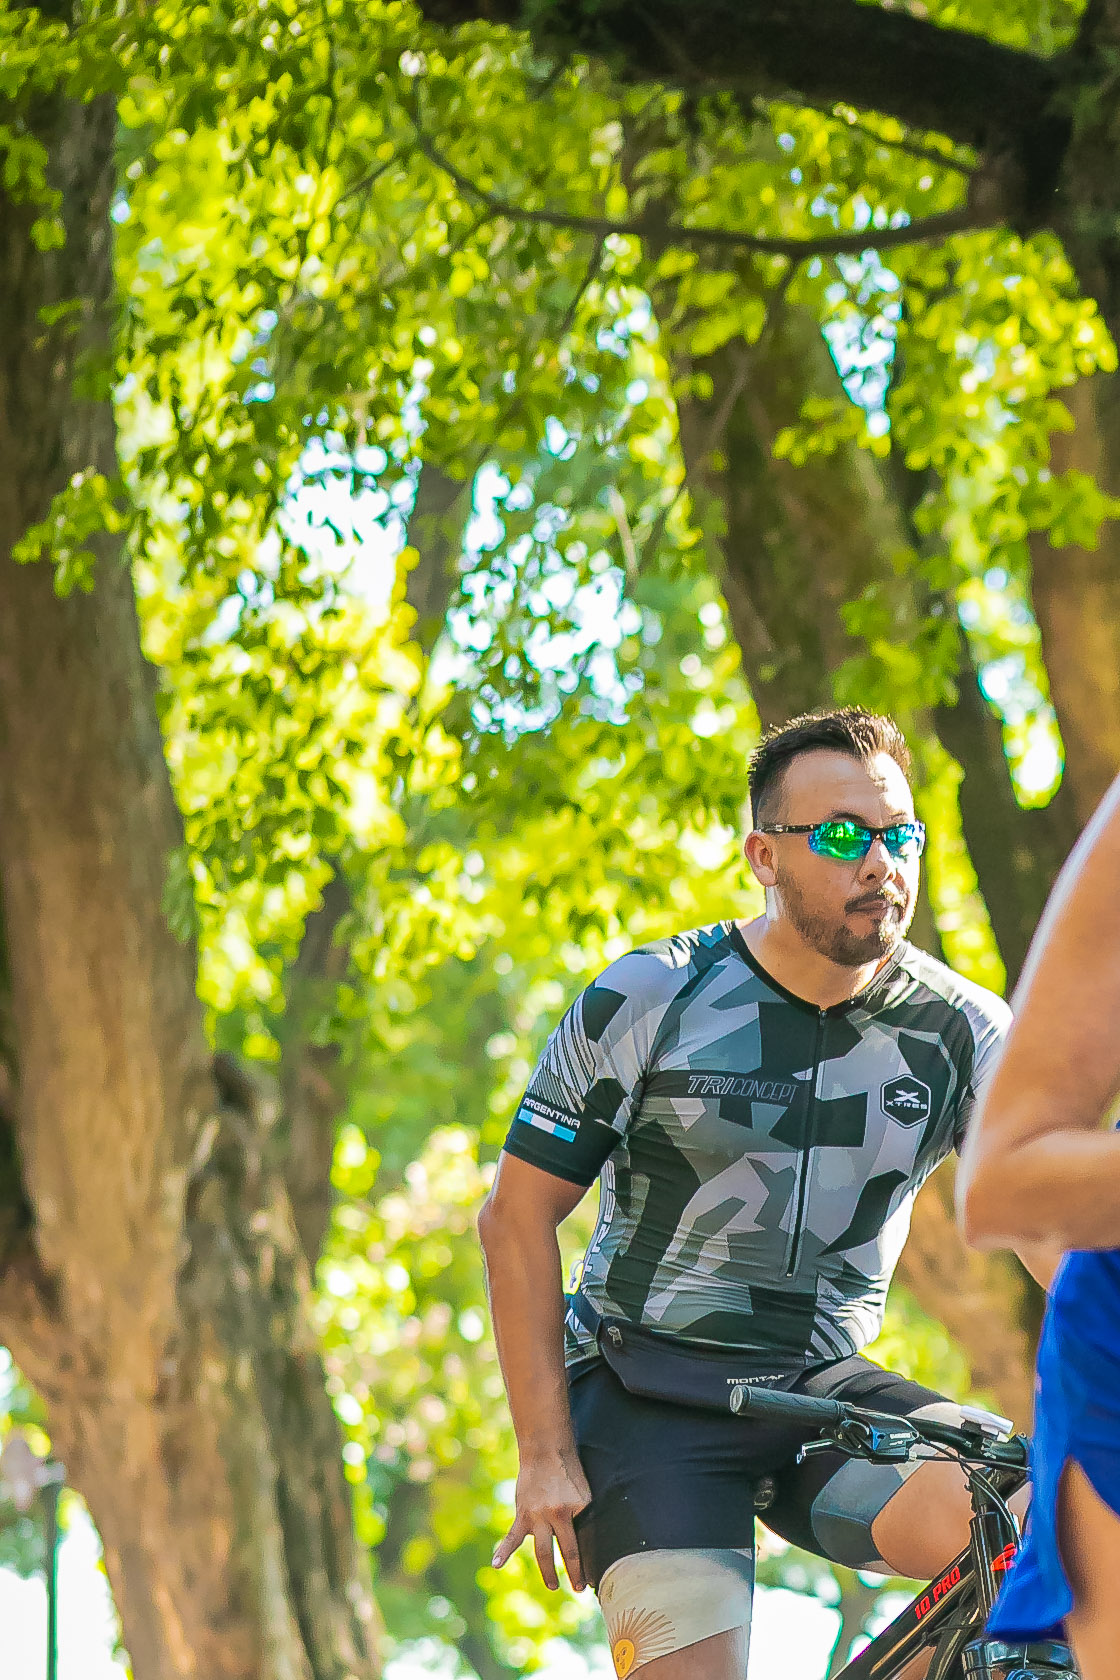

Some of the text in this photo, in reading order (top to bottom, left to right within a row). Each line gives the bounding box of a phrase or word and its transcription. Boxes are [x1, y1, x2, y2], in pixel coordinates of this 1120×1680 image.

[687, 1075, 799, 1104] TRICONCEPT
[523, 1097, 581, 1129] ARGENTINA
[914, 1565, 961, 1620] 10 PRO
